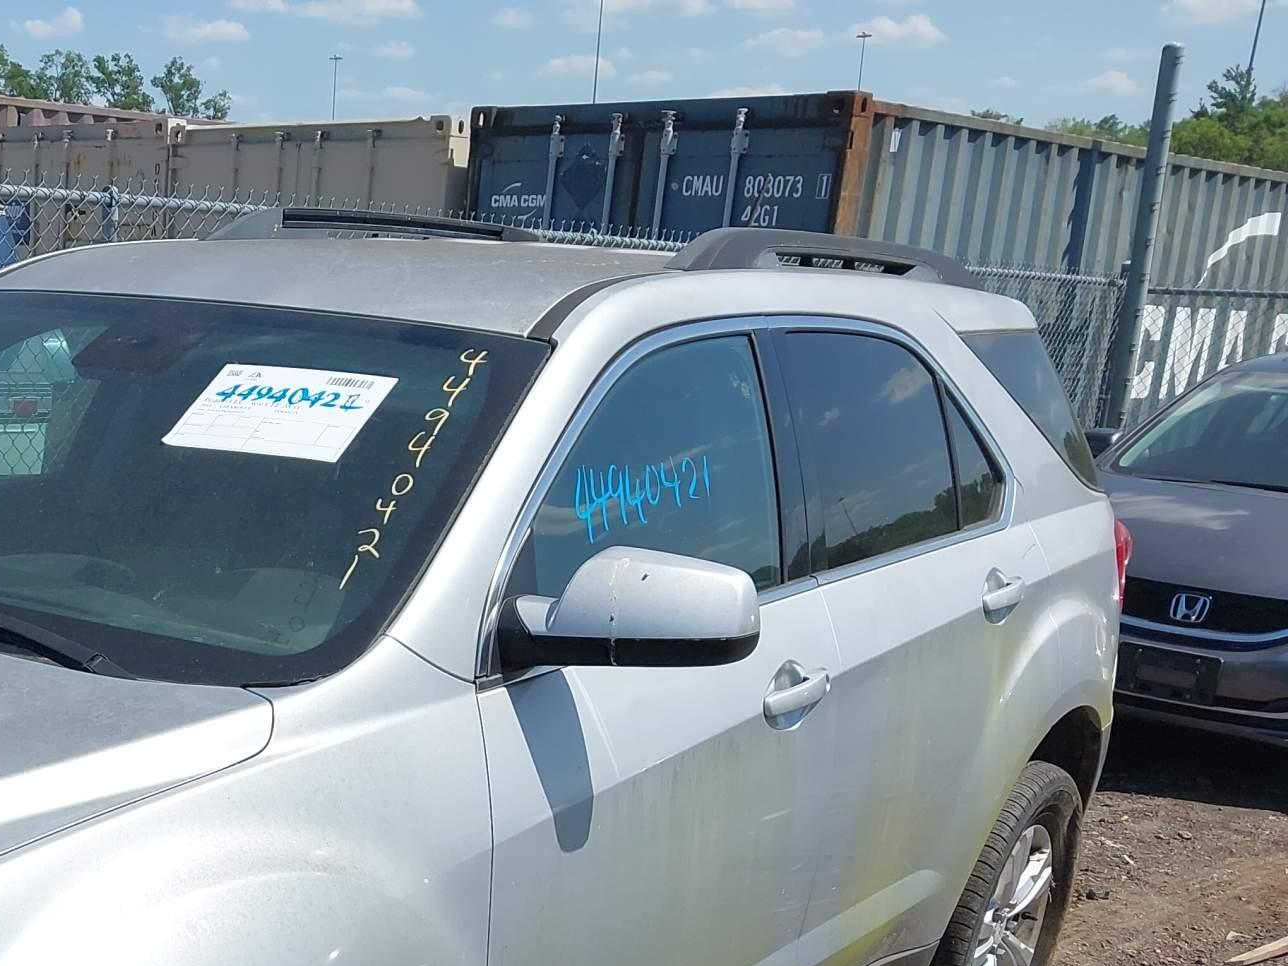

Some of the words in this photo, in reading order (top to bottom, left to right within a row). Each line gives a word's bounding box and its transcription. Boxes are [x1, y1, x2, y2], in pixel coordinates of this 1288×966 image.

[491, 194, 519, 207] CMA
[520, 194, 546, 207] CGM
[682, 175, 724, 197] CMAU
[743, 175, 803, 198] 803073
[741, 205, 779, 227] 42G1
[1130, 304, 1248, 399] CMA
[339, 348, 488, 590] 44940421
[575, 456, 710, 544] 44940421
